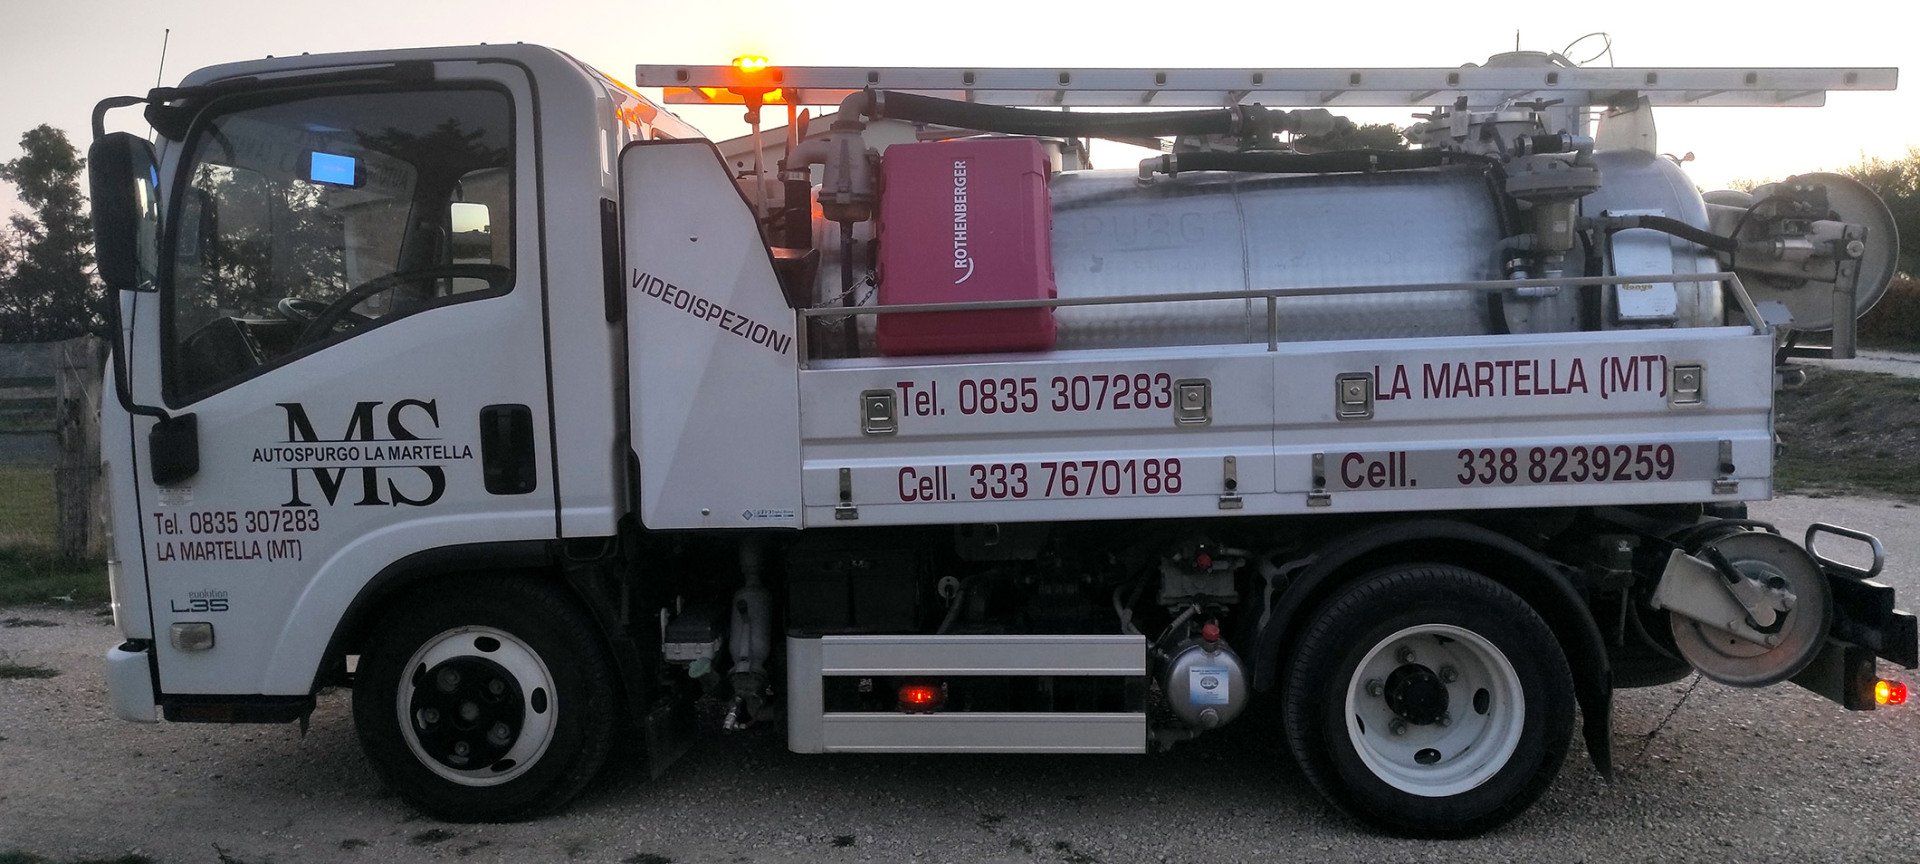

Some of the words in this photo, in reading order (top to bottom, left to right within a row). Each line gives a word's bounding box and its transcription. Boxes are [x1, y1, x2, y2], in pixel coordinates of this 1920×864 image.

[954, 160, 967, 269] ROTHENBERGER
[632, 268, 792, 354] VIDEOISPEZIONI
[897, 381, 944, 416] Tel.
[959, 378, 1037, 414] 0835
[1052, 373, 1171, 411] 307283
[1375, 365, 1411, 400] LA
[1424, 358, 1588, 399] MARTELLA
[1601, 355, 1667, 399] (MT)
[253, 447, 359, 462] AUTOSPURGO
[365, 446, 385, 460] LA
[388, 445, 473, 461] MARTELLA
[275, 399, 446, 507] MS
[1341, 452, 1416, 488] Cell.
[1458, 448, 1517, 485] 338
[1528, 444, 1674, 483] 8239259
[899, 466, 955, 501] Cell.
[970, 463, 1028, 499] 333
[1040, 458, 1181, 498] 7670188
[154, 513, 183, 534] Tel.
[190, 511, 238, 534] 0835
[245, 509, 319, 533] 307283
[157, 542, 176, 561] LA
[181, 541, 262, 560] MARTELLA
[267, 540, 301, 562] (MT)
[171, 599, 229, 612] L35
